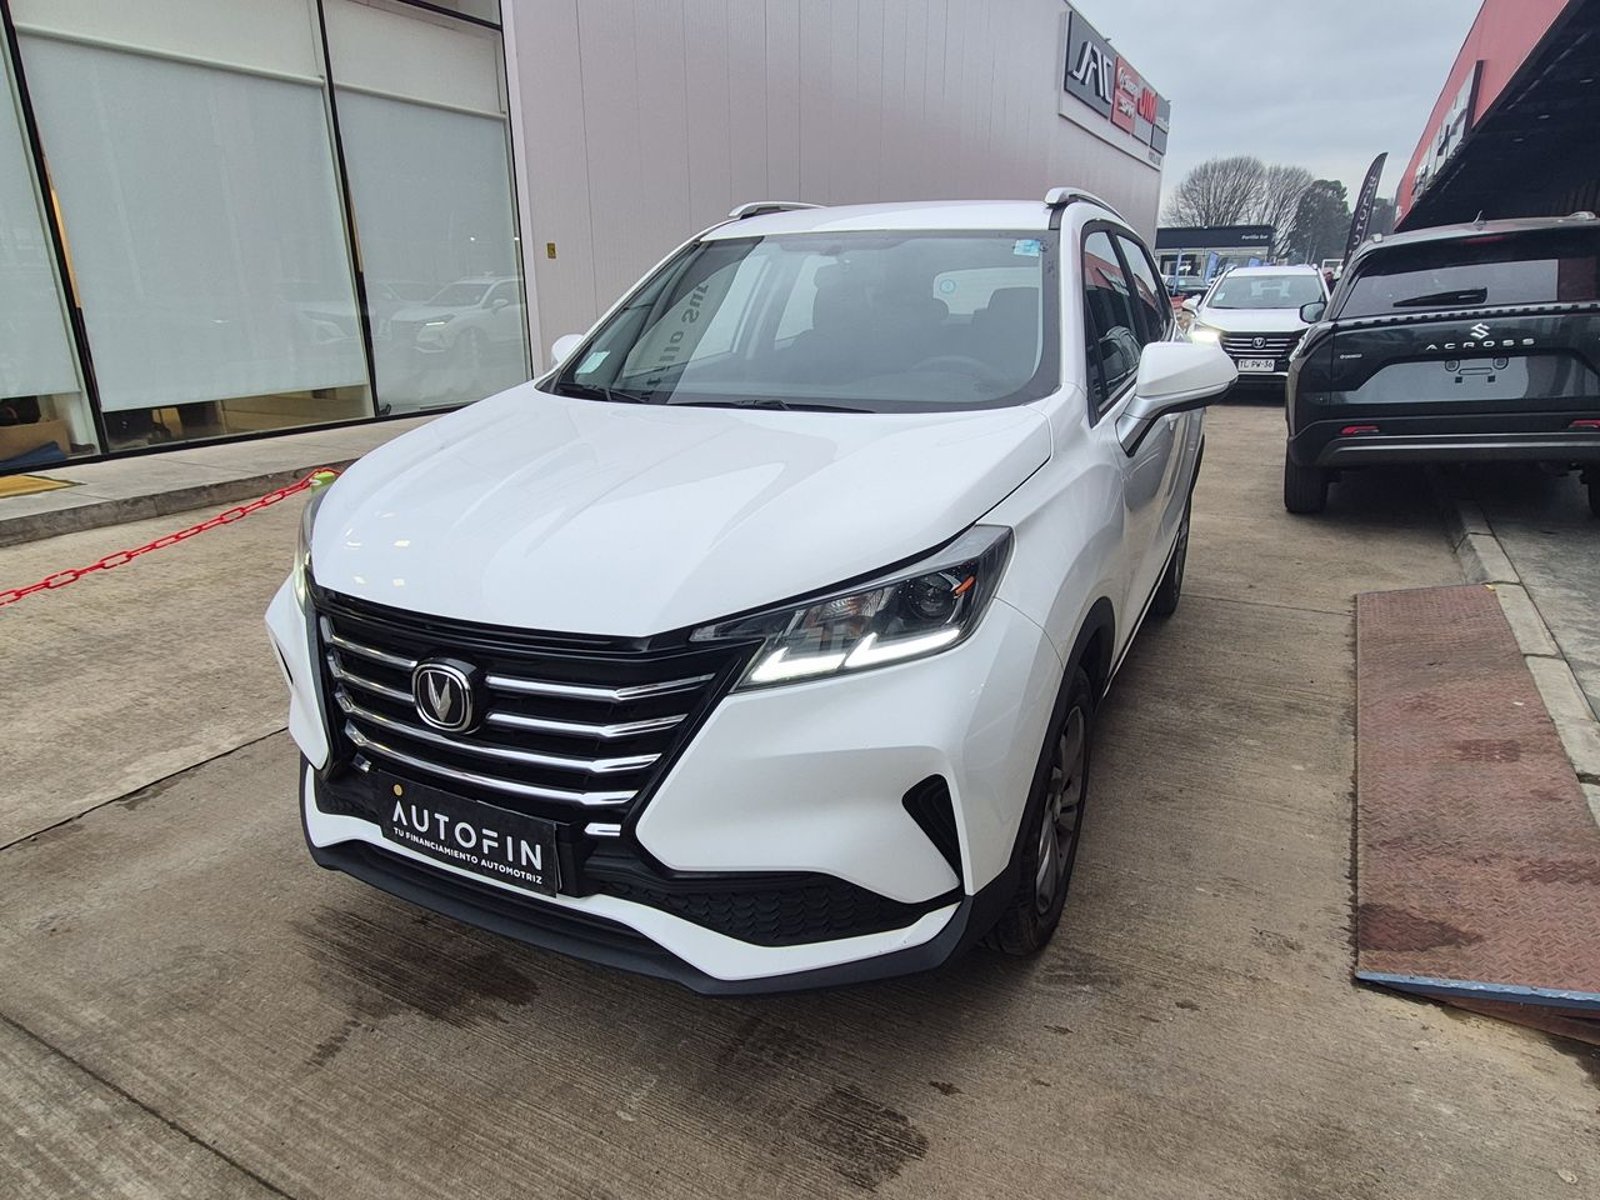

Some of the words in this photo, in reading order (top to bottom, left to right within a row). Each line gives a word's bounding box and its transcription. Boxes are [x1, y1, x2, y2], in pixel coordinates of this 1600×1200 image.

[1425, 338, 1535, 350] ACROSS
[392, 786, 543, 871] AUTOFIN
[393, 827, 404, 837] TU
[406, 832, 479, 864] FINANCIAMIENTO
[480, 859, 543, 884] AUTOMOTRIZ
